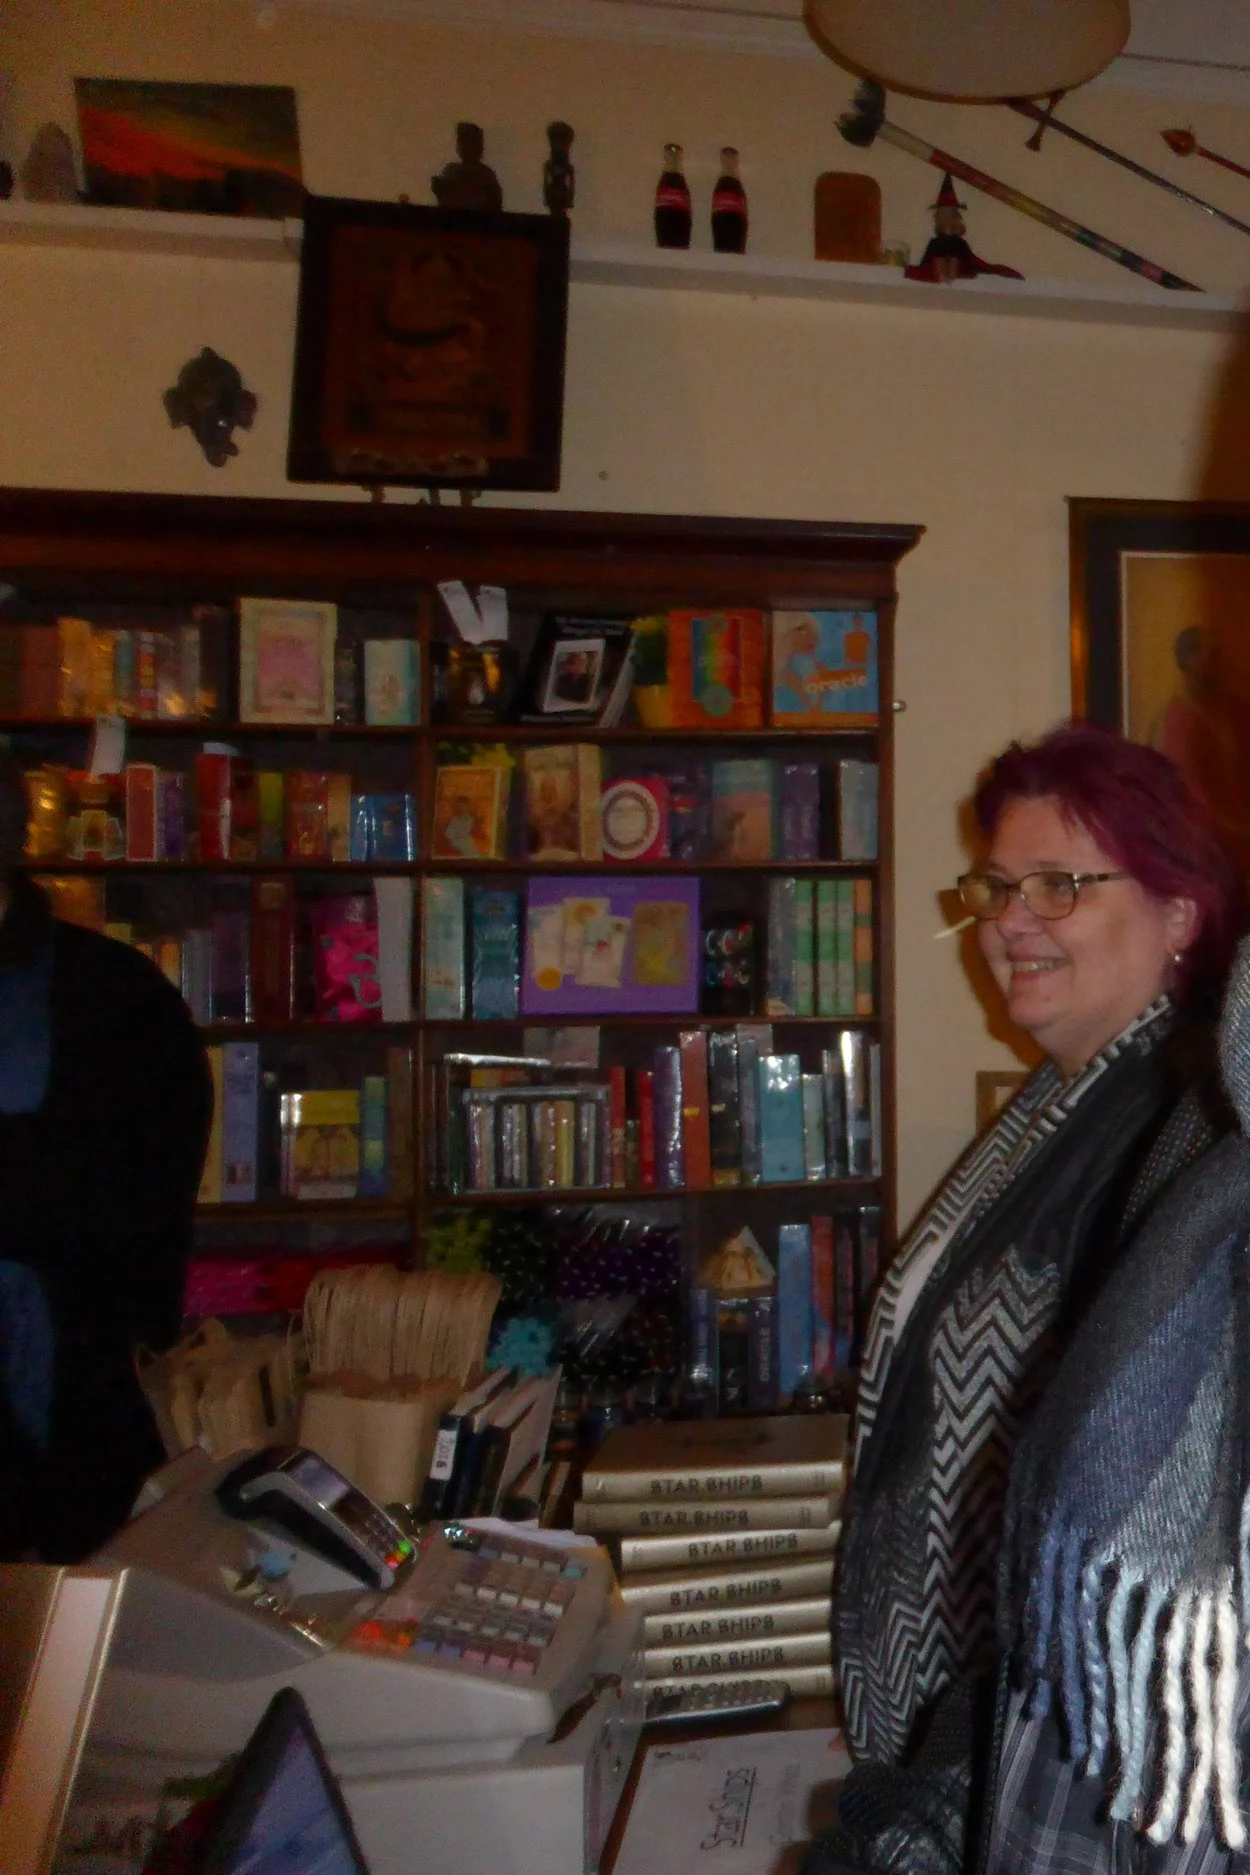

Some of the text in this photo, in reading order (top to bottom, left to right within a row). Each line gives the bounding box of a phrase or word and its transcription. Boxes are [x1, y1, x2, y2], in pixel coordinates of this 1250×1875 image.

[651, 1474, 763, 1495] STAR SHIPS
[640, 1509, 749, 1527] STAR SHIPS
[688, 1532, 798, 1559] STAR SHIPS
[670, 1578, 783, 1606] STAR SHIPS
[662, 1615, 775, 1641] STAR SHIPS
[672, 1646, 784, 1672] STAR SHIPS
